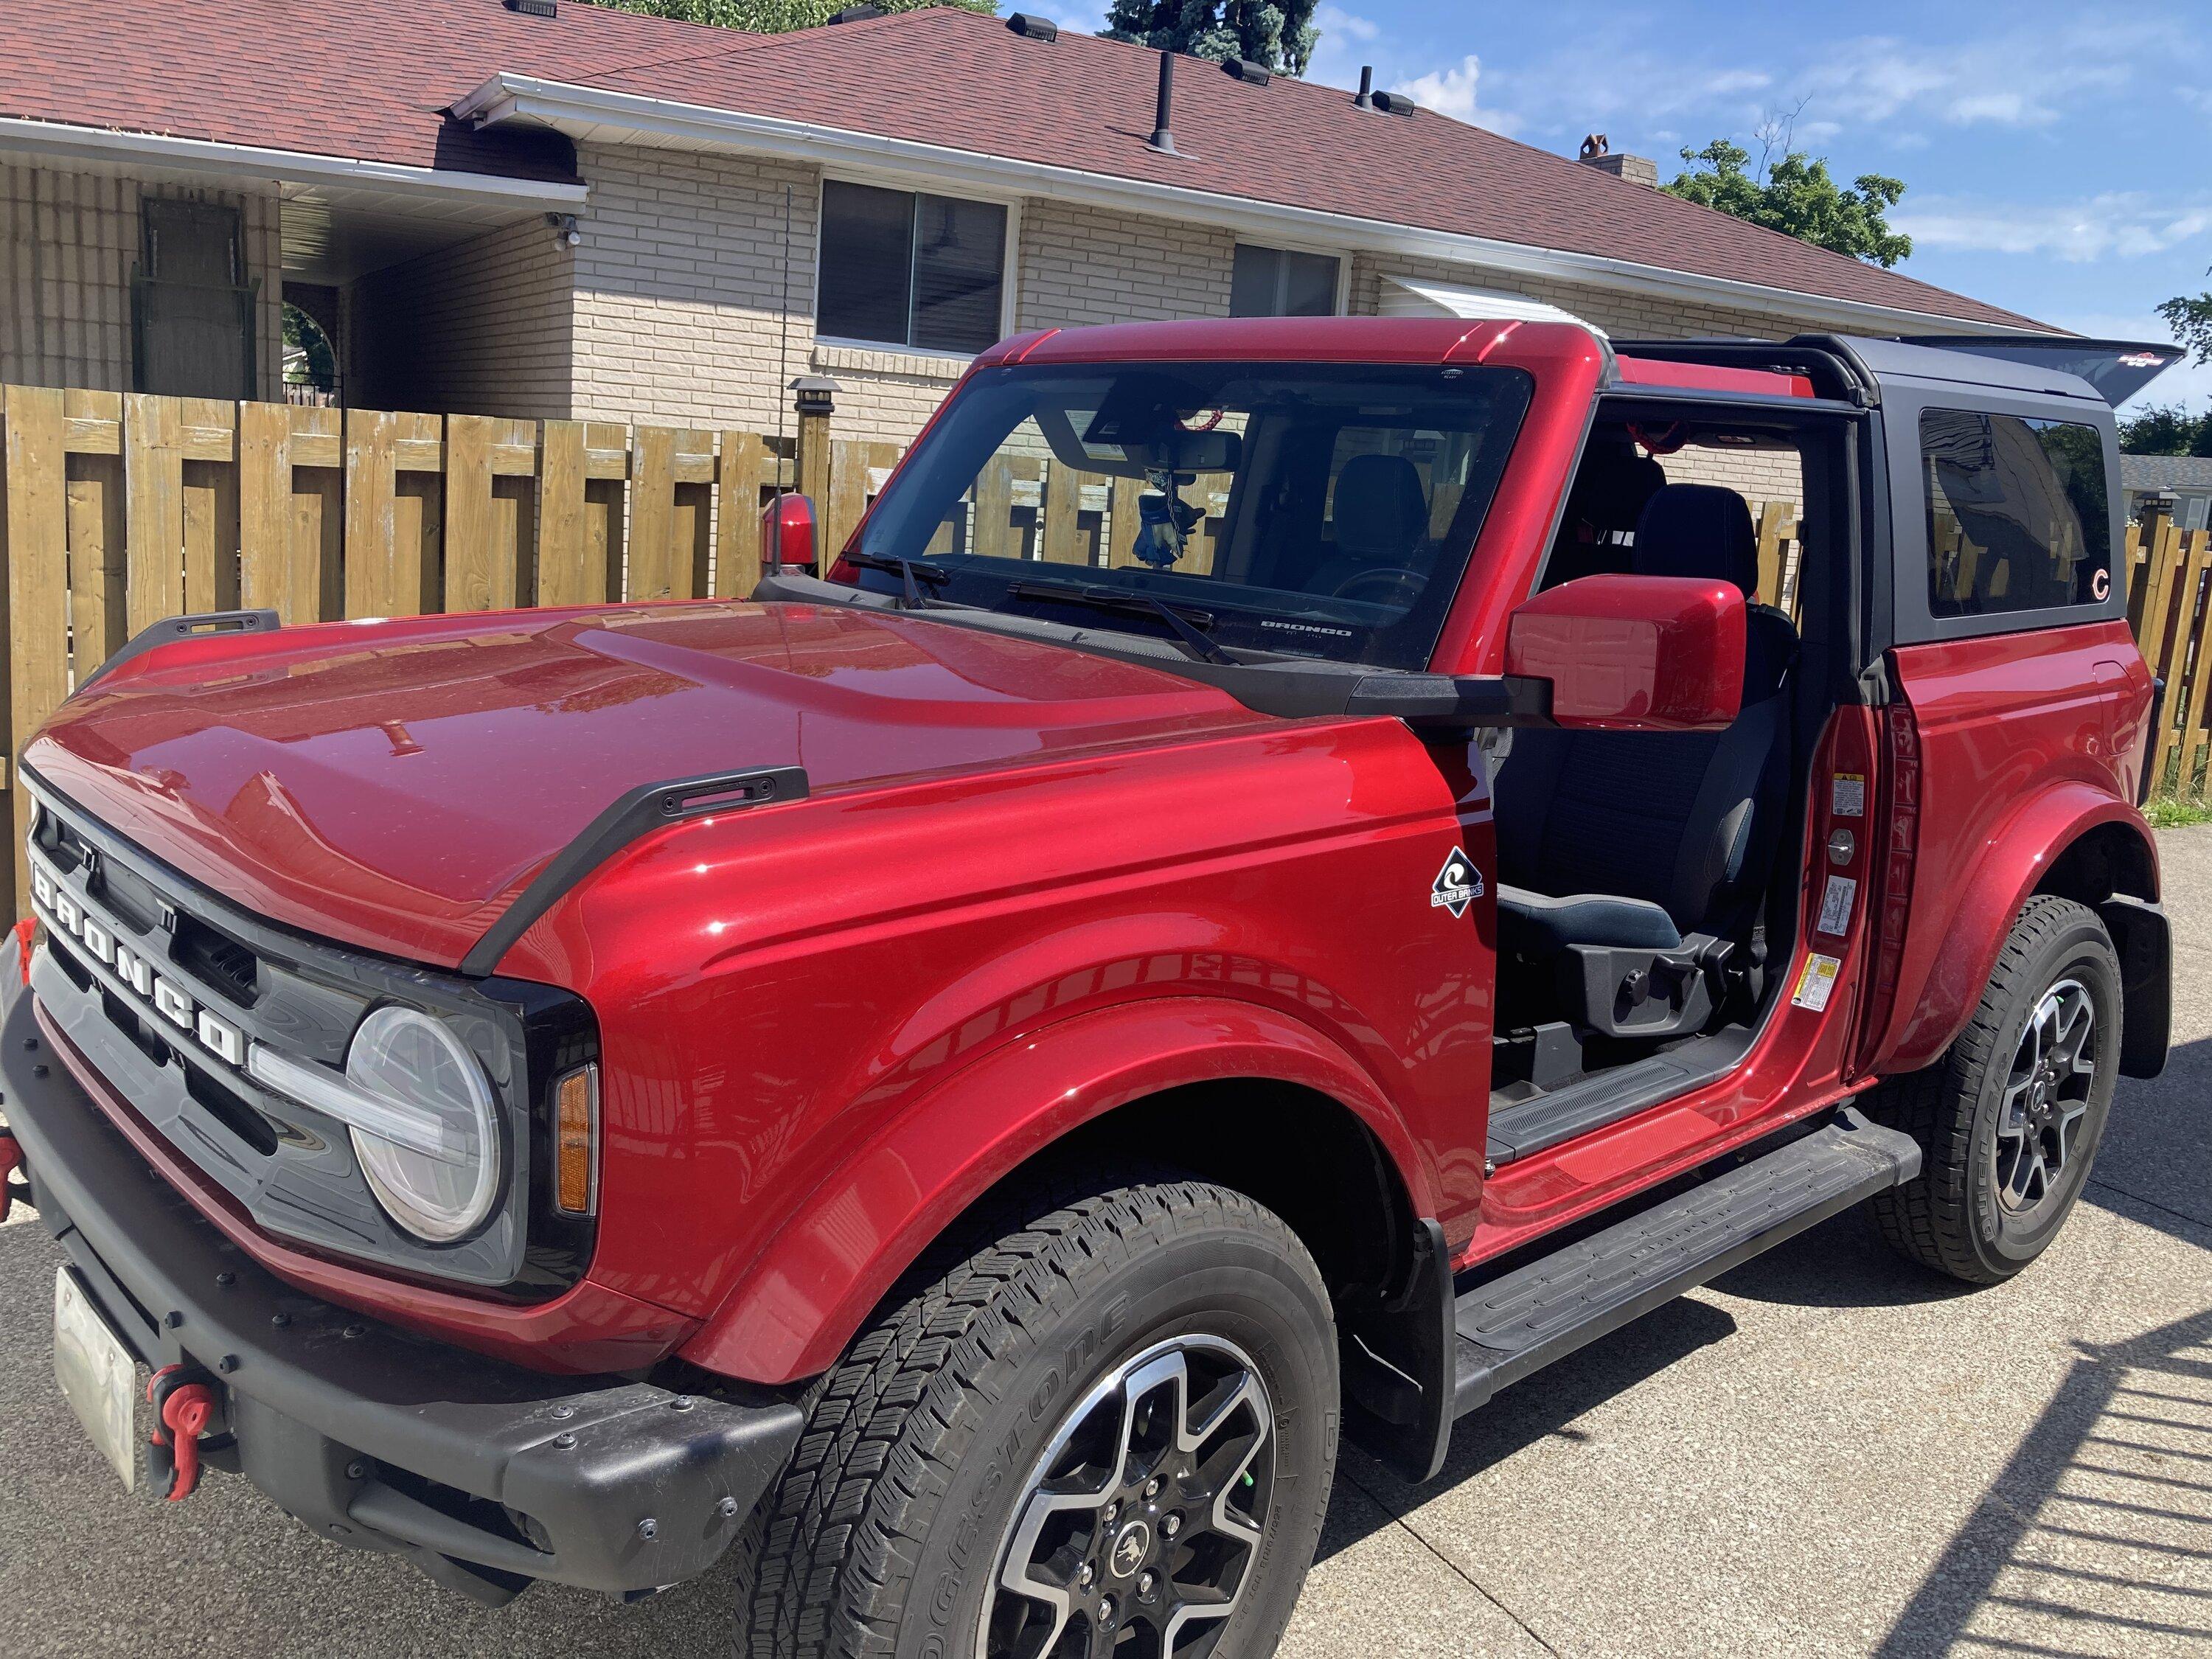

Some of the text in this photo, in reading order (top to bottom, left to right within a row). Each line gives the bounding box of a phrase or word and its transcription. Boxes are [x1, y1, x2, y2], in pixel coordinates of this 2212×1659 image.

[1261, 621, 1352, 637] BRONCO
[1433, 886, 1482, 904] OUTER BANKS
[35, 866, 244, 1066] BRONCO
